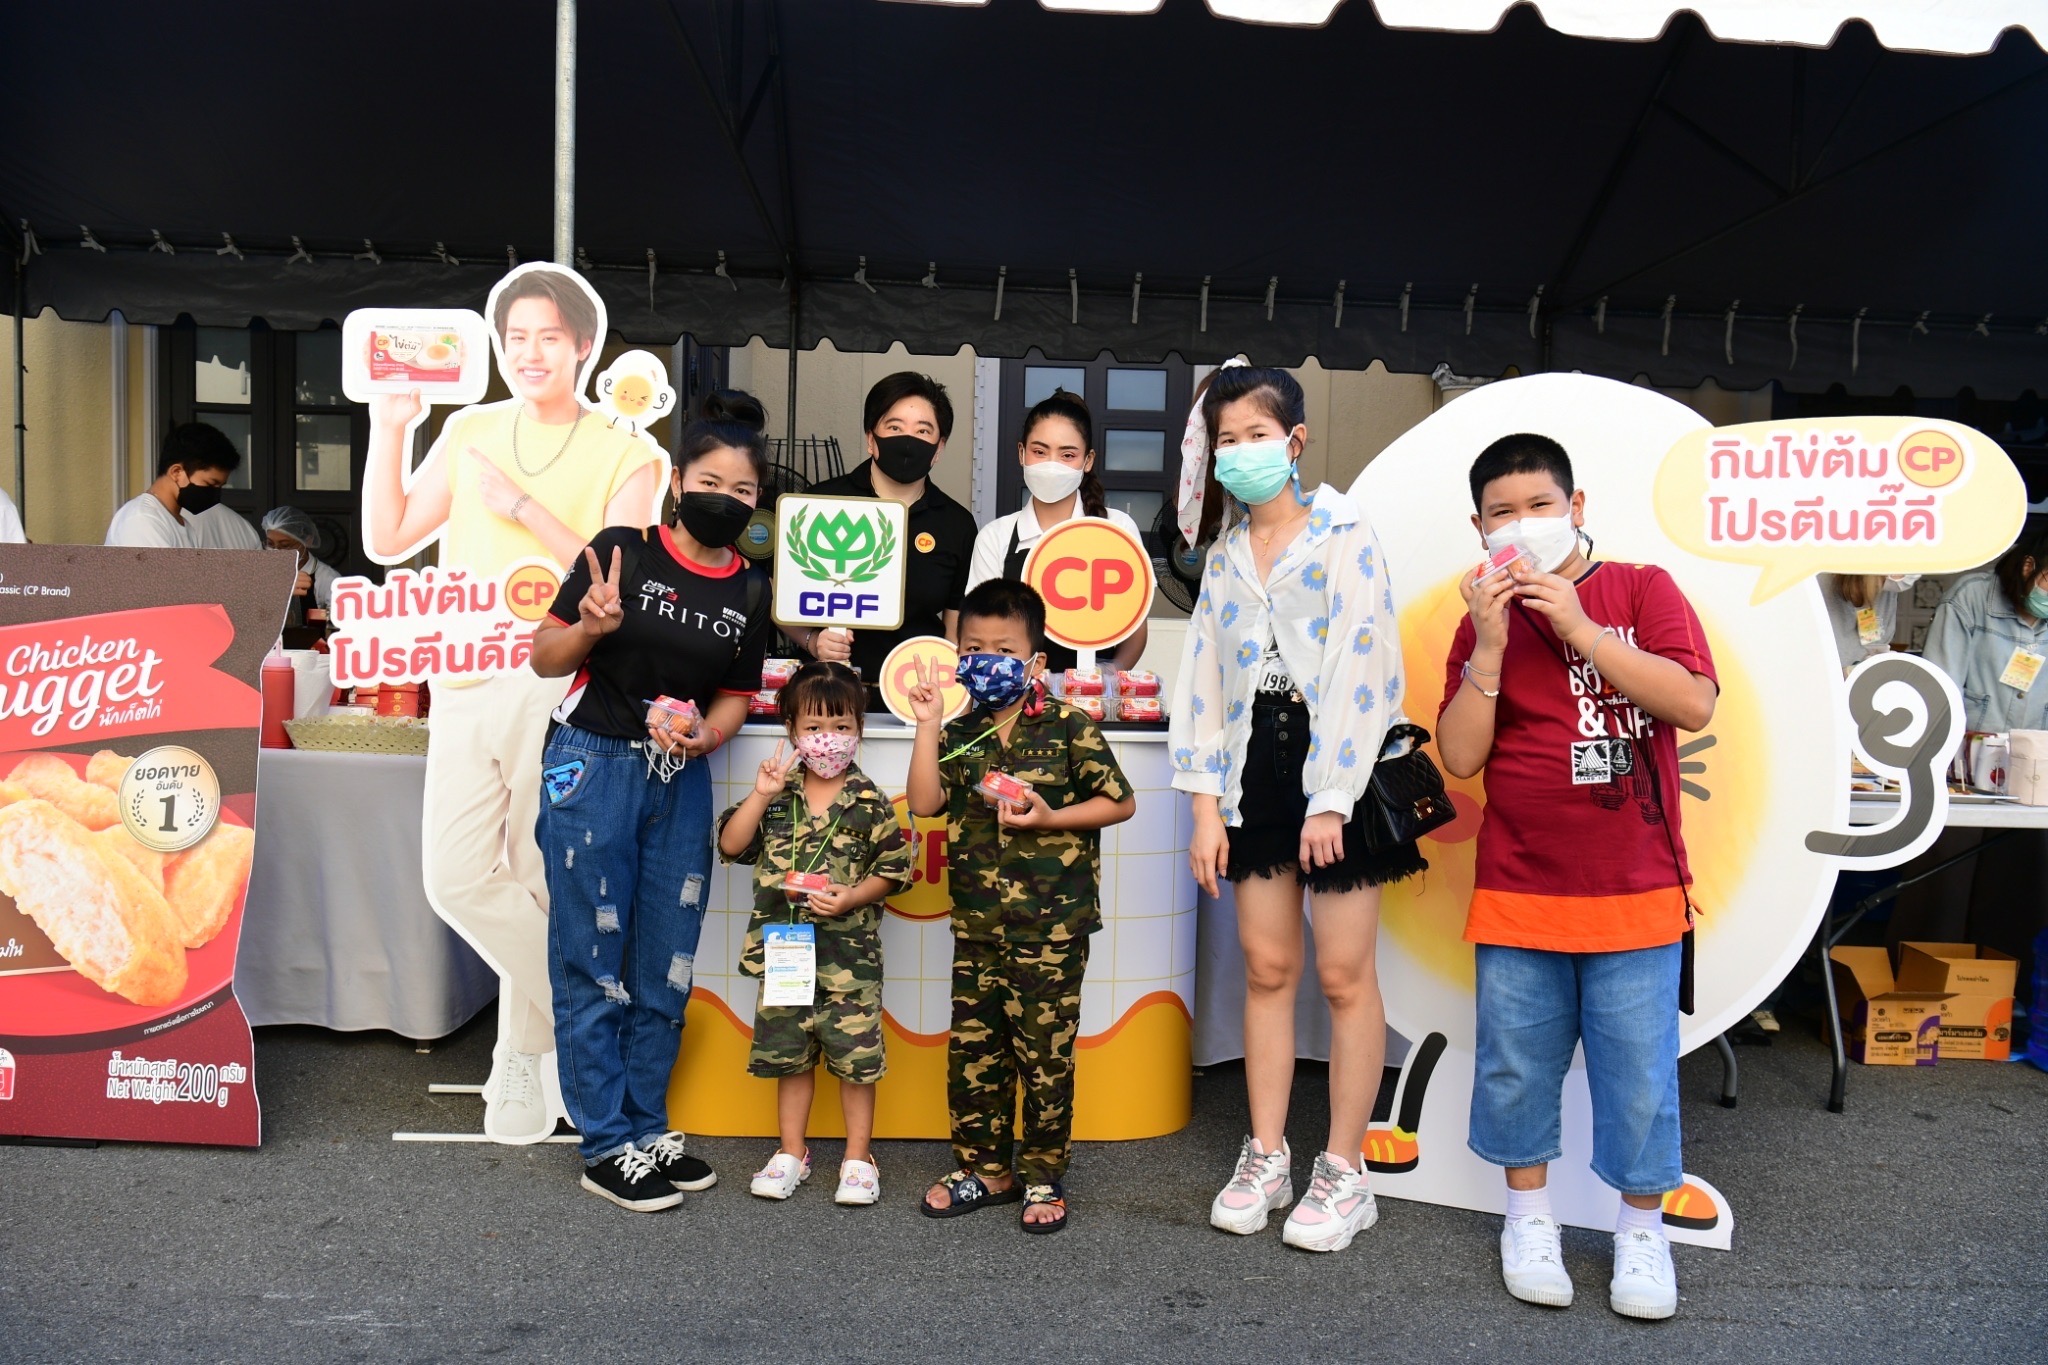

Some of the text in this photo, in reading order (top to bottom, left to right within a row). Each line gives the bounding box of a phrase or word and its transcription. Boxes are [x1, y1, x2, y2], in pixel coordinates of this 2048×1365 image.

[1710, 434, 1957, 479] กินไข่ต้ม CP
[1708, 483, 1936, 541] โปรตีนดี๊ดี
[917, 537, 933, 548] CP
[0, 584, 21, 595] assic
[41, 585, 71, 598] Brand)
[335, 571, 555, 622] กินไข่ต้ม CP
[641, 583, 678, 601] GT3
[1041, 556, 1134, 612] CP
[799, 591, 879, 619] CPF
[6, 634, 140, 677] Chicken
[0, 648, 165, 737] ugget
[98, 699, 163, 728] นักเก็ตไก่
[134, 764, 201, 781] ยอดขาย
[156, 780, 183, 791] อันดับ
[158, 794, 179, 832] 1
[107, 1078, 229, 1107] Net Weight g
[109, 1052, 245, 1102] น้ำหนักสุทธิ 200 กรัม
